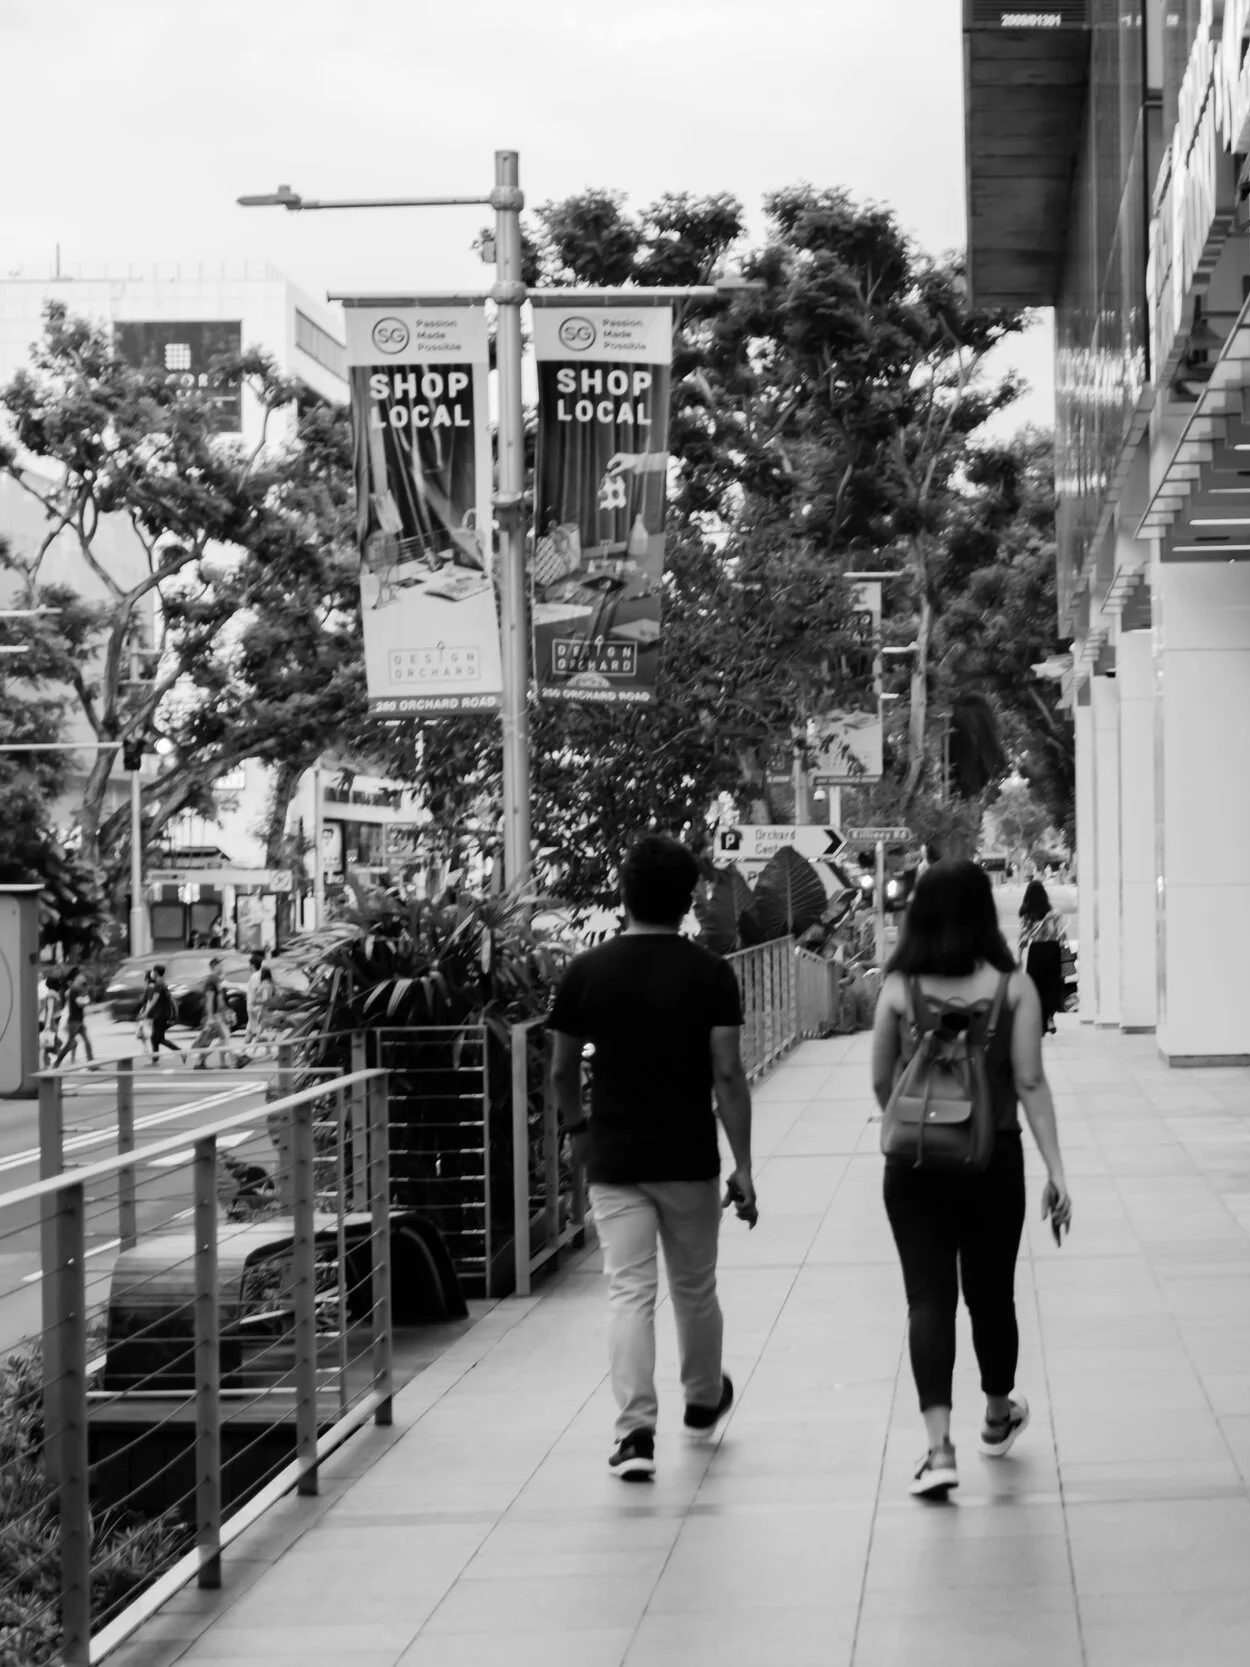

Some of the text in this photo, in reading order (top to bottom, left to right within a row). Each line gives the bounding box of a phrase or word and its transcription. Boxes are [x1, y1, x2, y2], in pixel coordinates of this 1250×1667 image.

[416, 319, 457, 328] Passion
[602, 318, 643, 327] Passion
[417, 331, 446, 340] Made
[603, 330, 632, 338] Made
[417, 343, 462, 352] Possible
[604, 341, 647, 350] Possible
[369, 371, 469, 400] SHOP
[557, 368, 652, 397] SHOP
[371, 404, 471, 429] LOCAL
[557, 399, 652, 426] LOCAL
[394, 651, 476, 666] DESIGN
[394, 665, 476, 680] ORCHARD
[562, 688, 617, 701] ORCHARD
[618, 690, 650, 702] ROAD
[399, 698, 459, 712] ORCHARD
[461, 695, 497, 709] ROAD
[755, 829, 796, 841] Orchard
